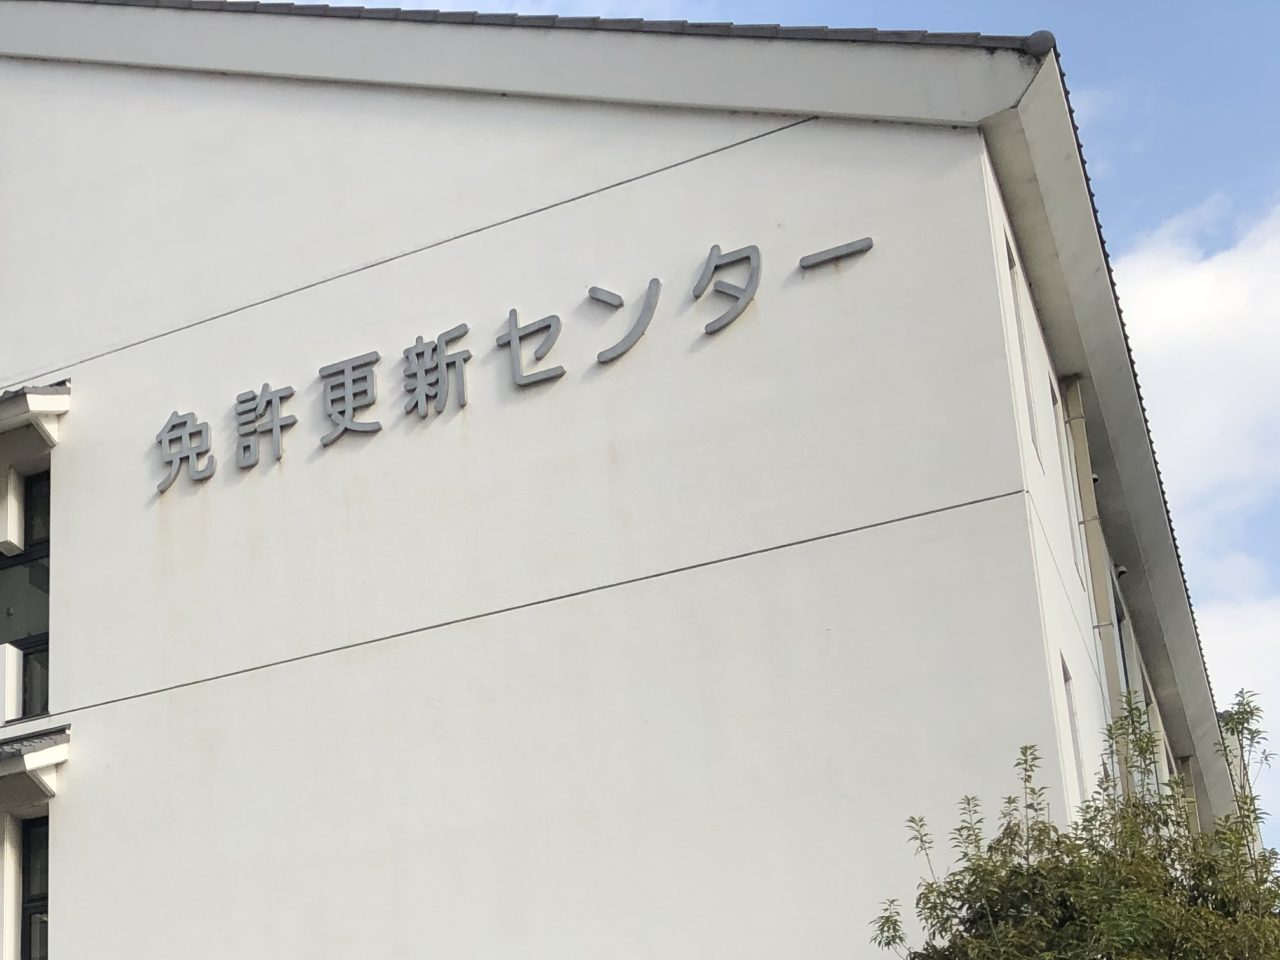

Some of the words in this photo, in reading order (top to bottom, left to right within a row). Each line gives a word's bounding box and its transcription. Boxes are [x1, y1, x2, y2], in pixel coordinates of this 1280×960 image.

[155, 237, 875, 494] 免許更新センター
